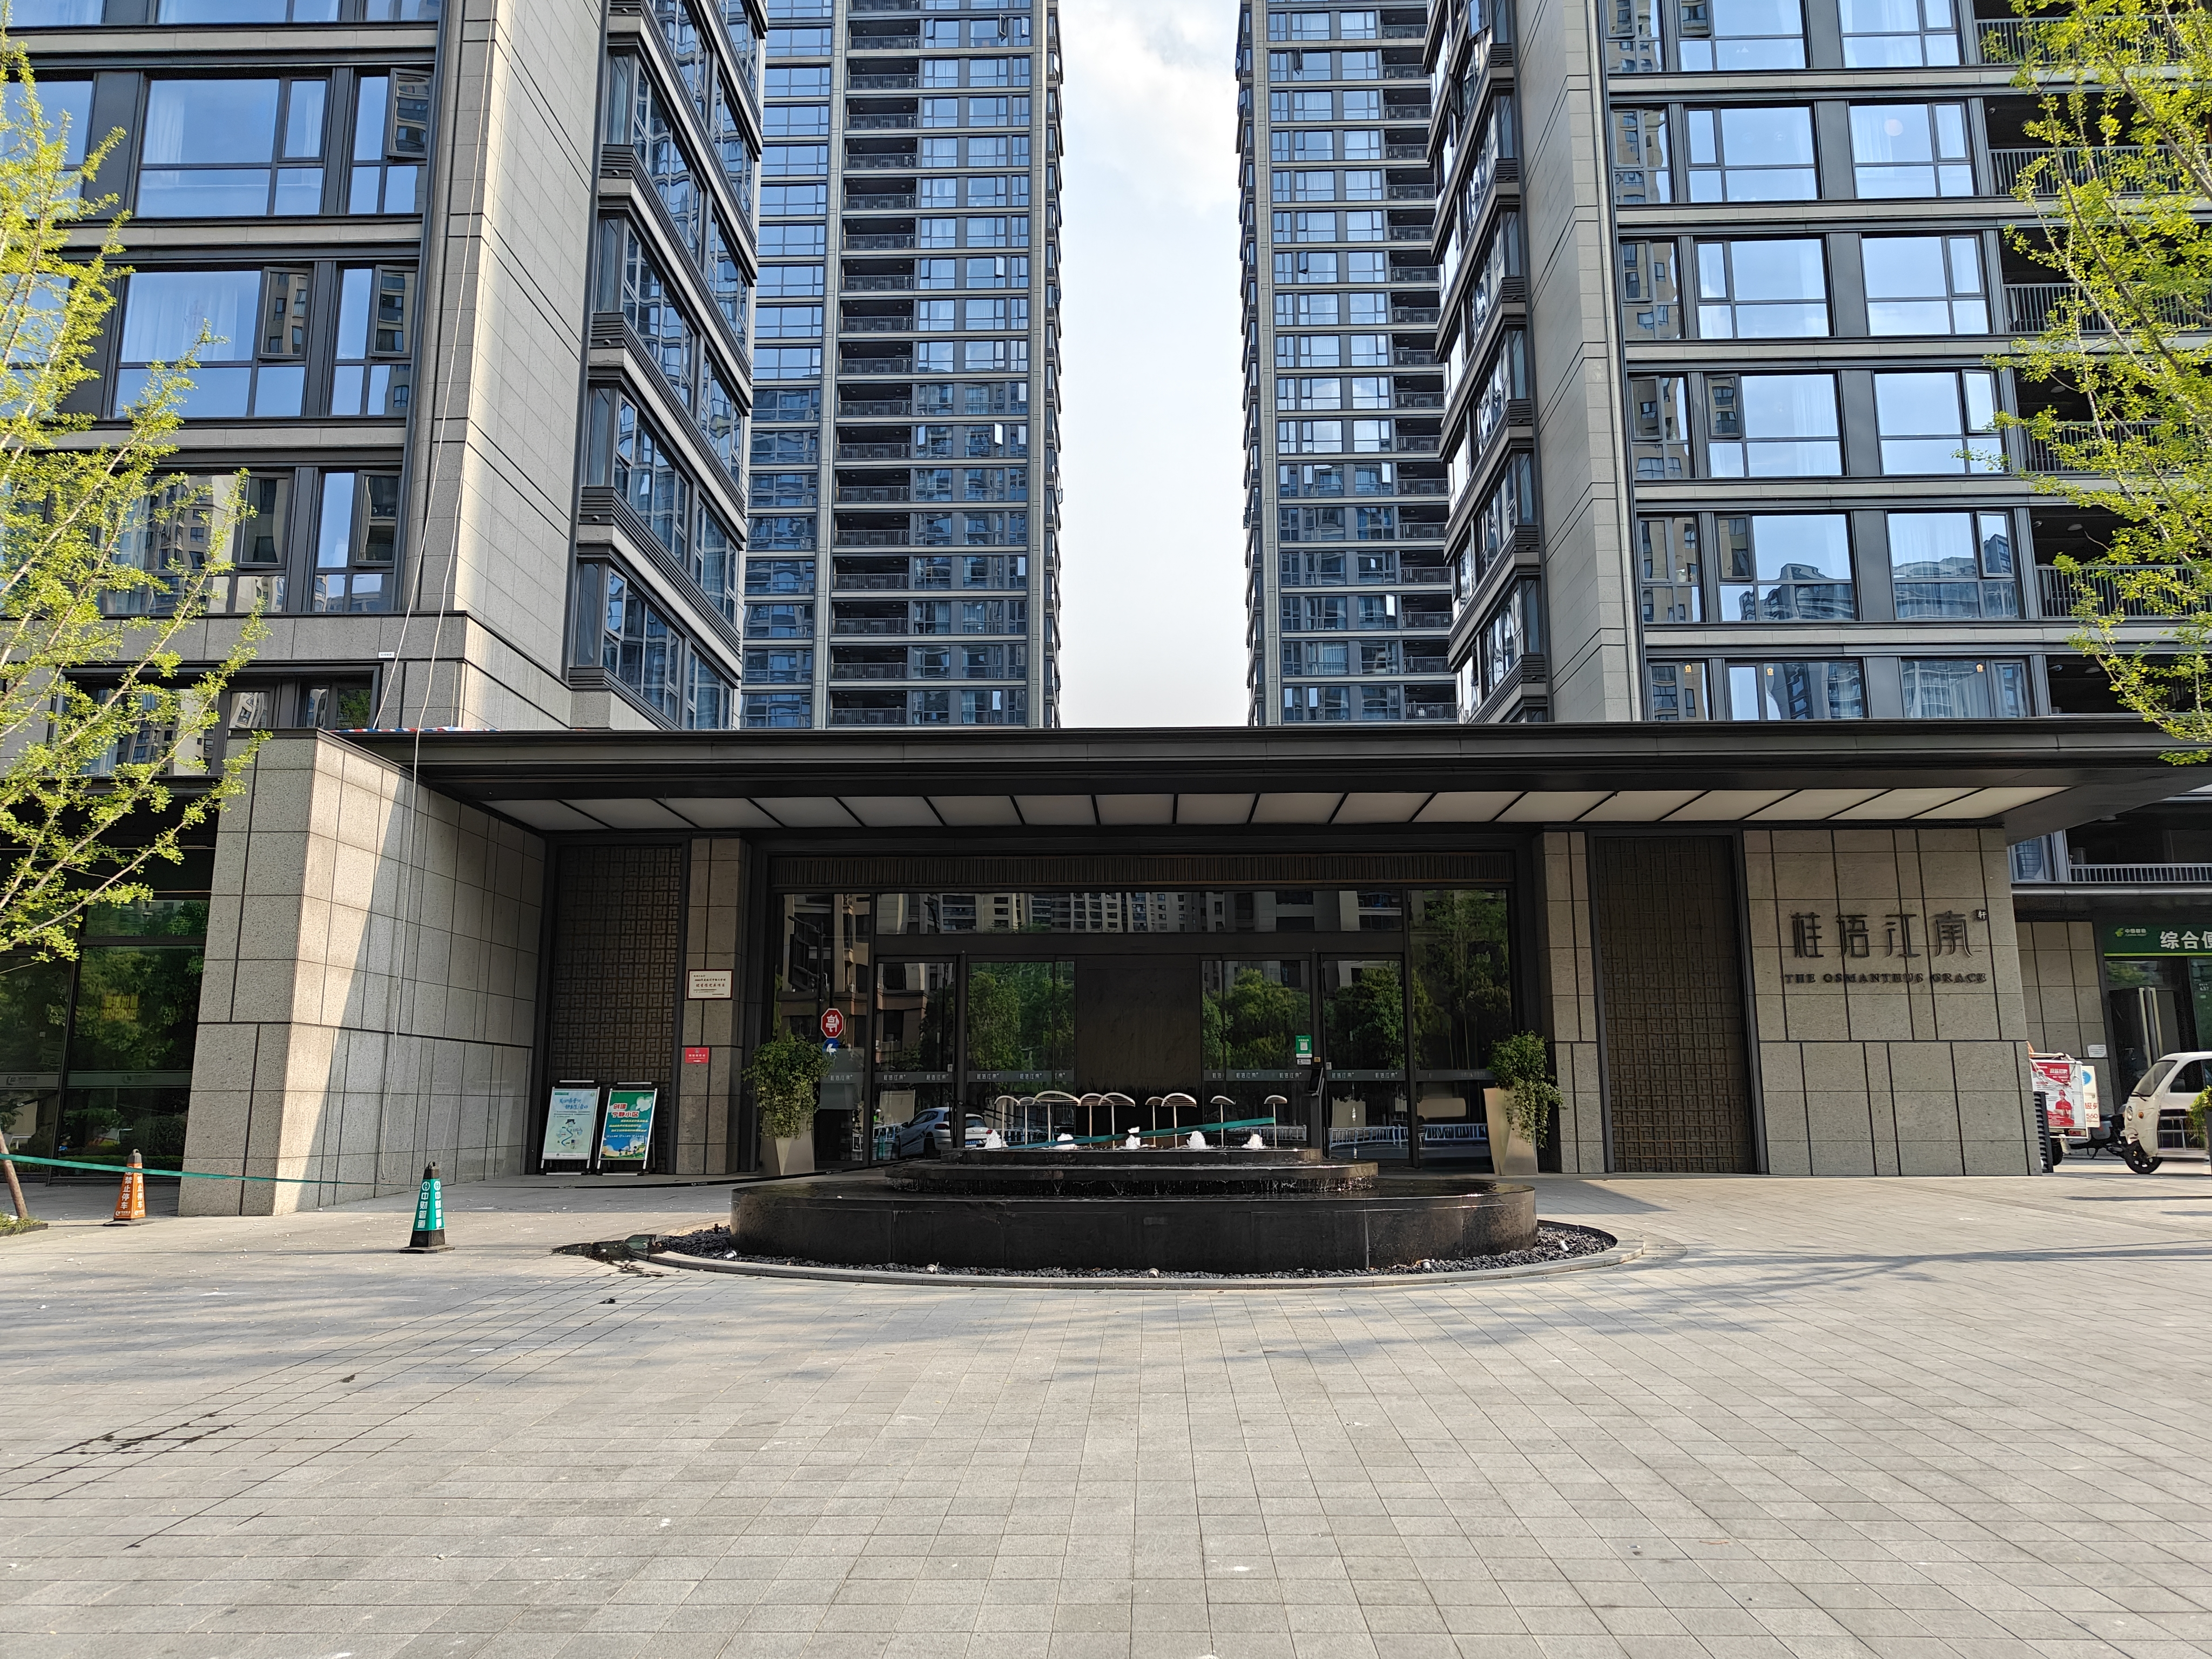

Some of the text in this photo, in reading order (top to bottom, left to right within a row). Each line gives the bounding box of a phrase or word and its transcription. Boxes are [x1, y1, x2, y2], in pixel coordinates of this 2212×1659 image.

[1790, 911, 1973, 958] 桂语江南
[1784, 973, 1987, 983] THE OSMANTHUS GRACE
[120, 1176, 133, 1210] 禁止停车
